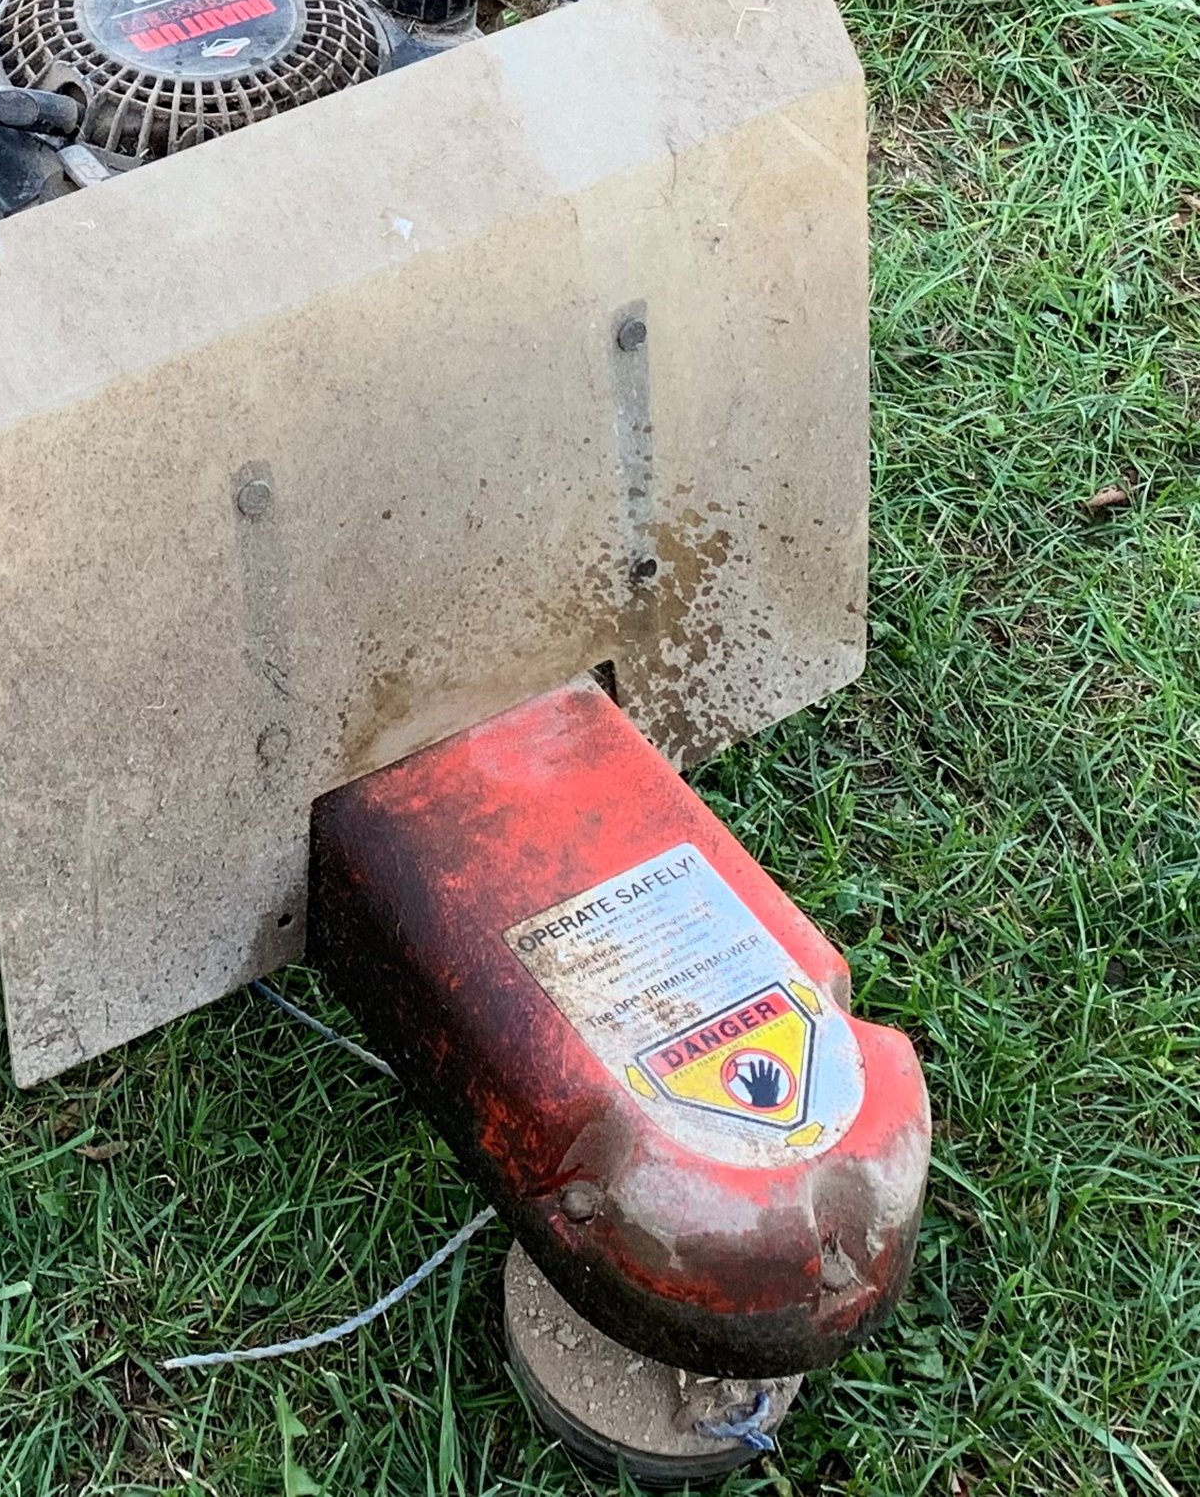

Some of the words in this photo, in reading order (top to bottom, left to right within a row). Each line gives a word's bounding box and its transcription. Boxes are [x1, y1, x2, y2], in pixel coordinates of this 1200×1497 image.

[515, 895, 616, 955] OPERATE
[613, 854, 701, 906] SAFELY!
[584, 1008, 615, 1030] The
[641, 932, 762, 1002] TRIMMER/MOWER
[660, 997, 777, 1069] DANGER
